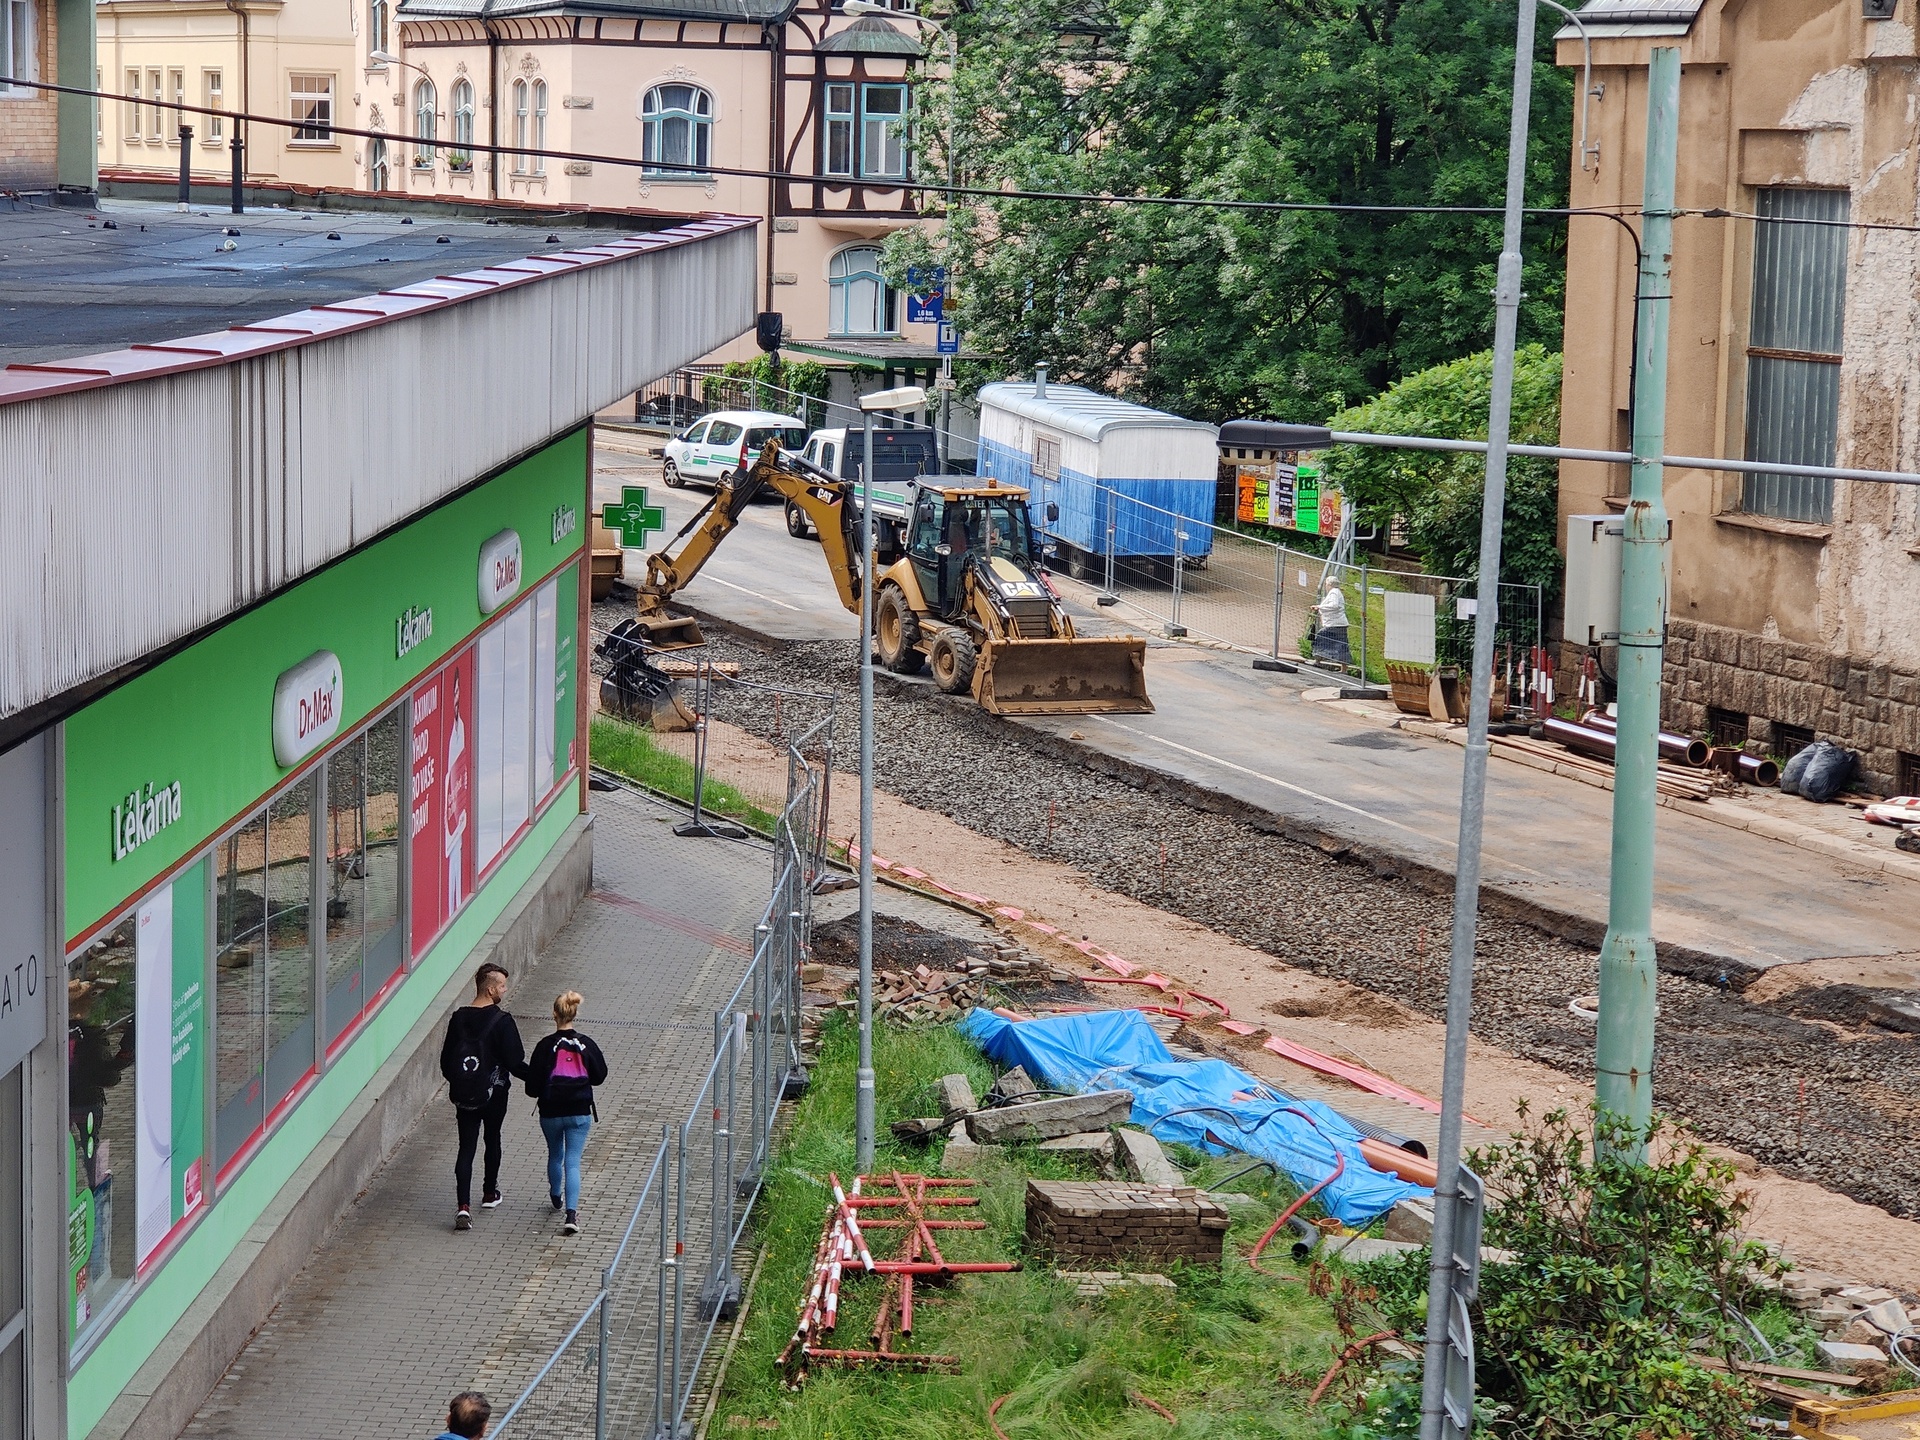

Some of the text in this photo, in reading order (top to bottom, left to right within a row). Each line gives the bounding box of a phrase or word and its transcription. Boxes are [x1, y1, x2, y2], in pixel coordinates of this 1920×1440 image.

[817, 488, 834, 504] CAT
[551, 504, 576, 544] Lékárna
[496, 554, 516, 592] Dr.Max
[1000, 582, 1041, 597] CAT
[397, 604, 432, 658] Lékárna
[299, 687, 333, 739] Dr.Max
[420, 756, 434, 794] VAŠE
[113, 780, 181, 862] Lékárna
